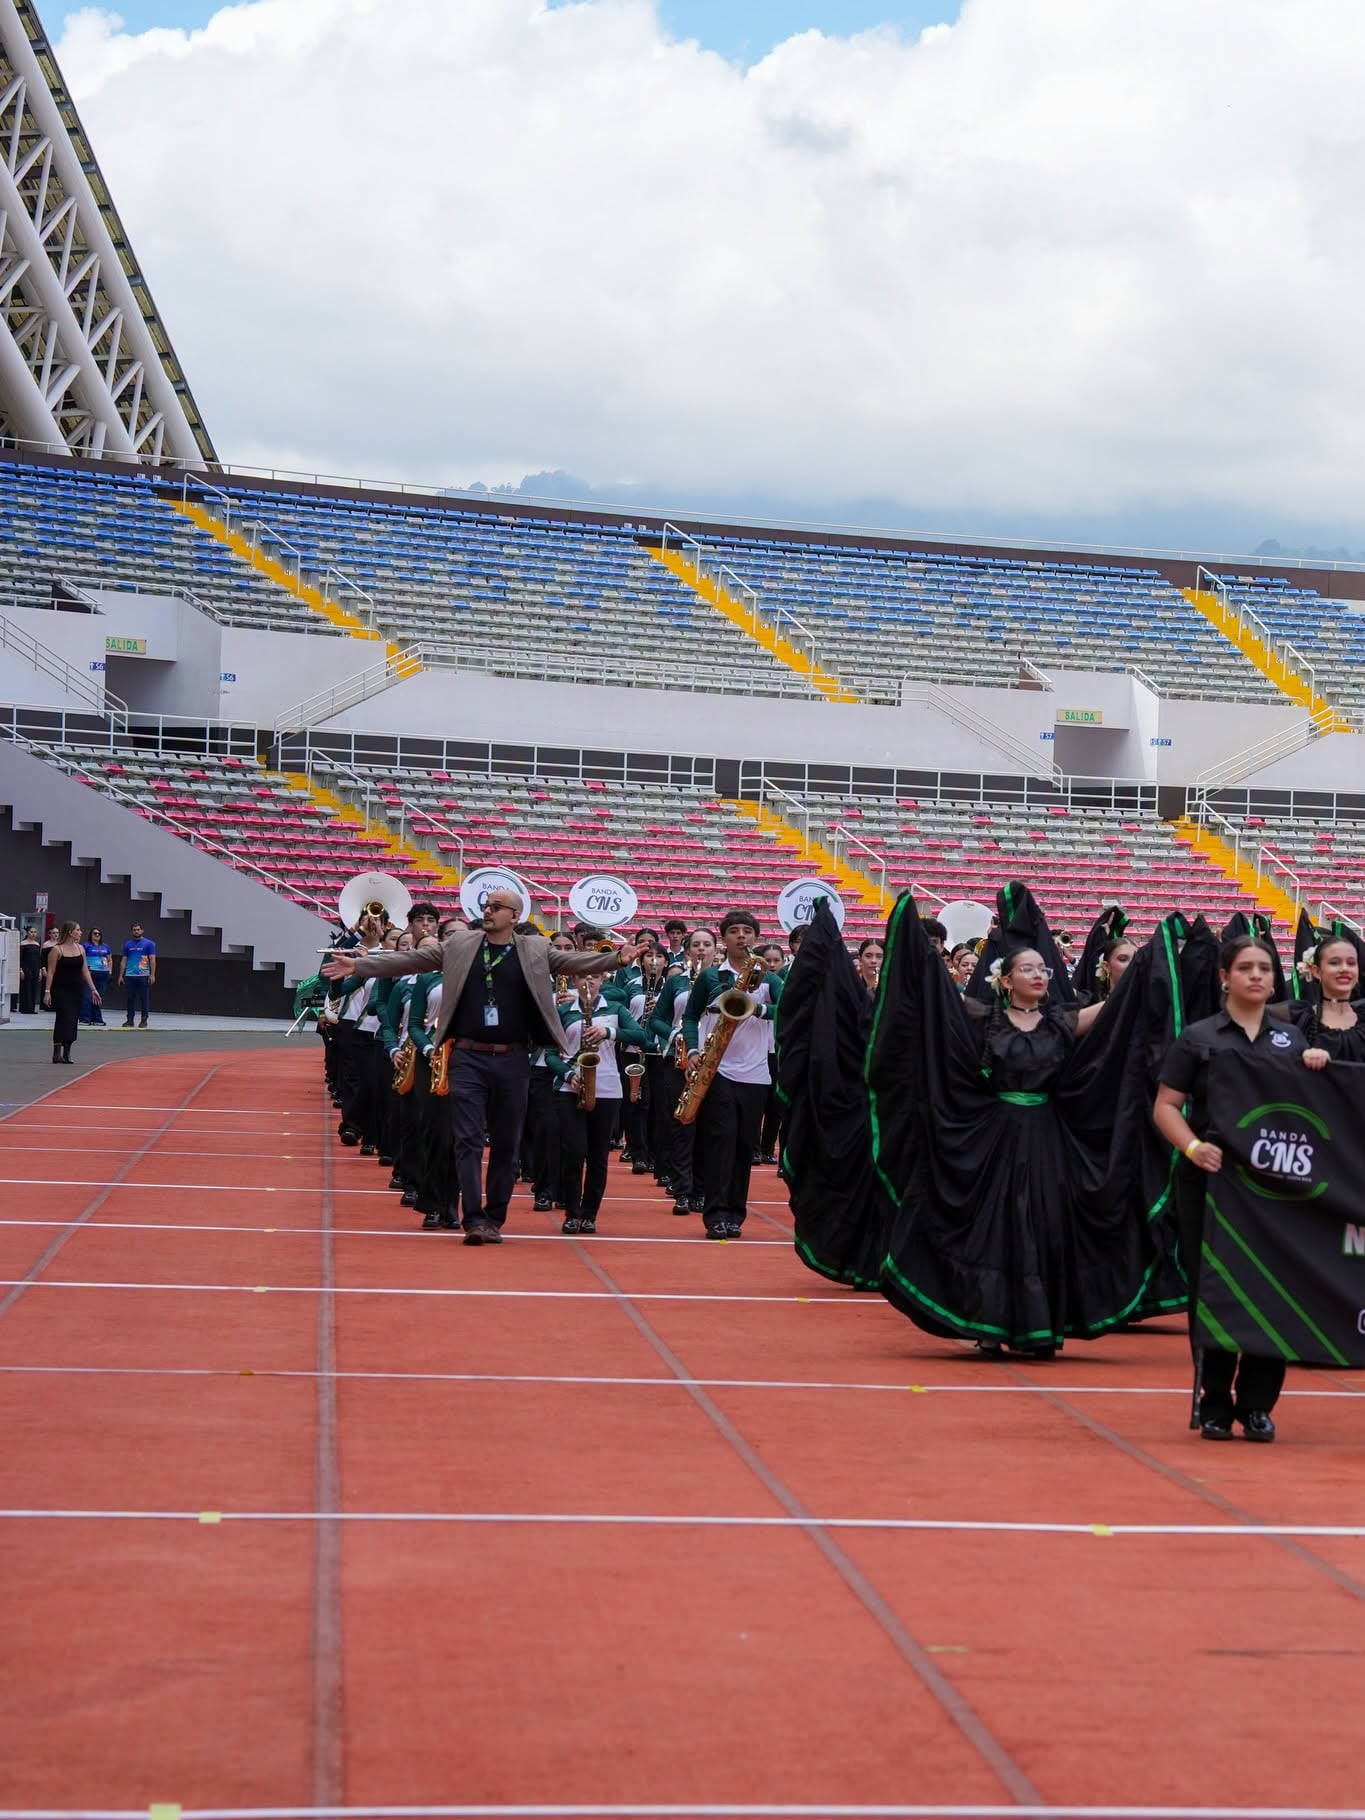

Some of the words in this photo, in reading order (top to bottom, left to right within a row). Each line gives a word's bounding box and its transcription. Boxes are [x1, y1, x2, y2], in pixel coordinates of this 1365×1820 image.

[106, 638, 138, 651] SALIDA
[1064, 711, 1096, 721] SALIDA
[591, 887, 618, 896] BANDA
[586, 895, 622, 912] CNS
[1260, 1128, 1308, 1143] BANDA
[1250, 1139, 1314, 1176] CNS
